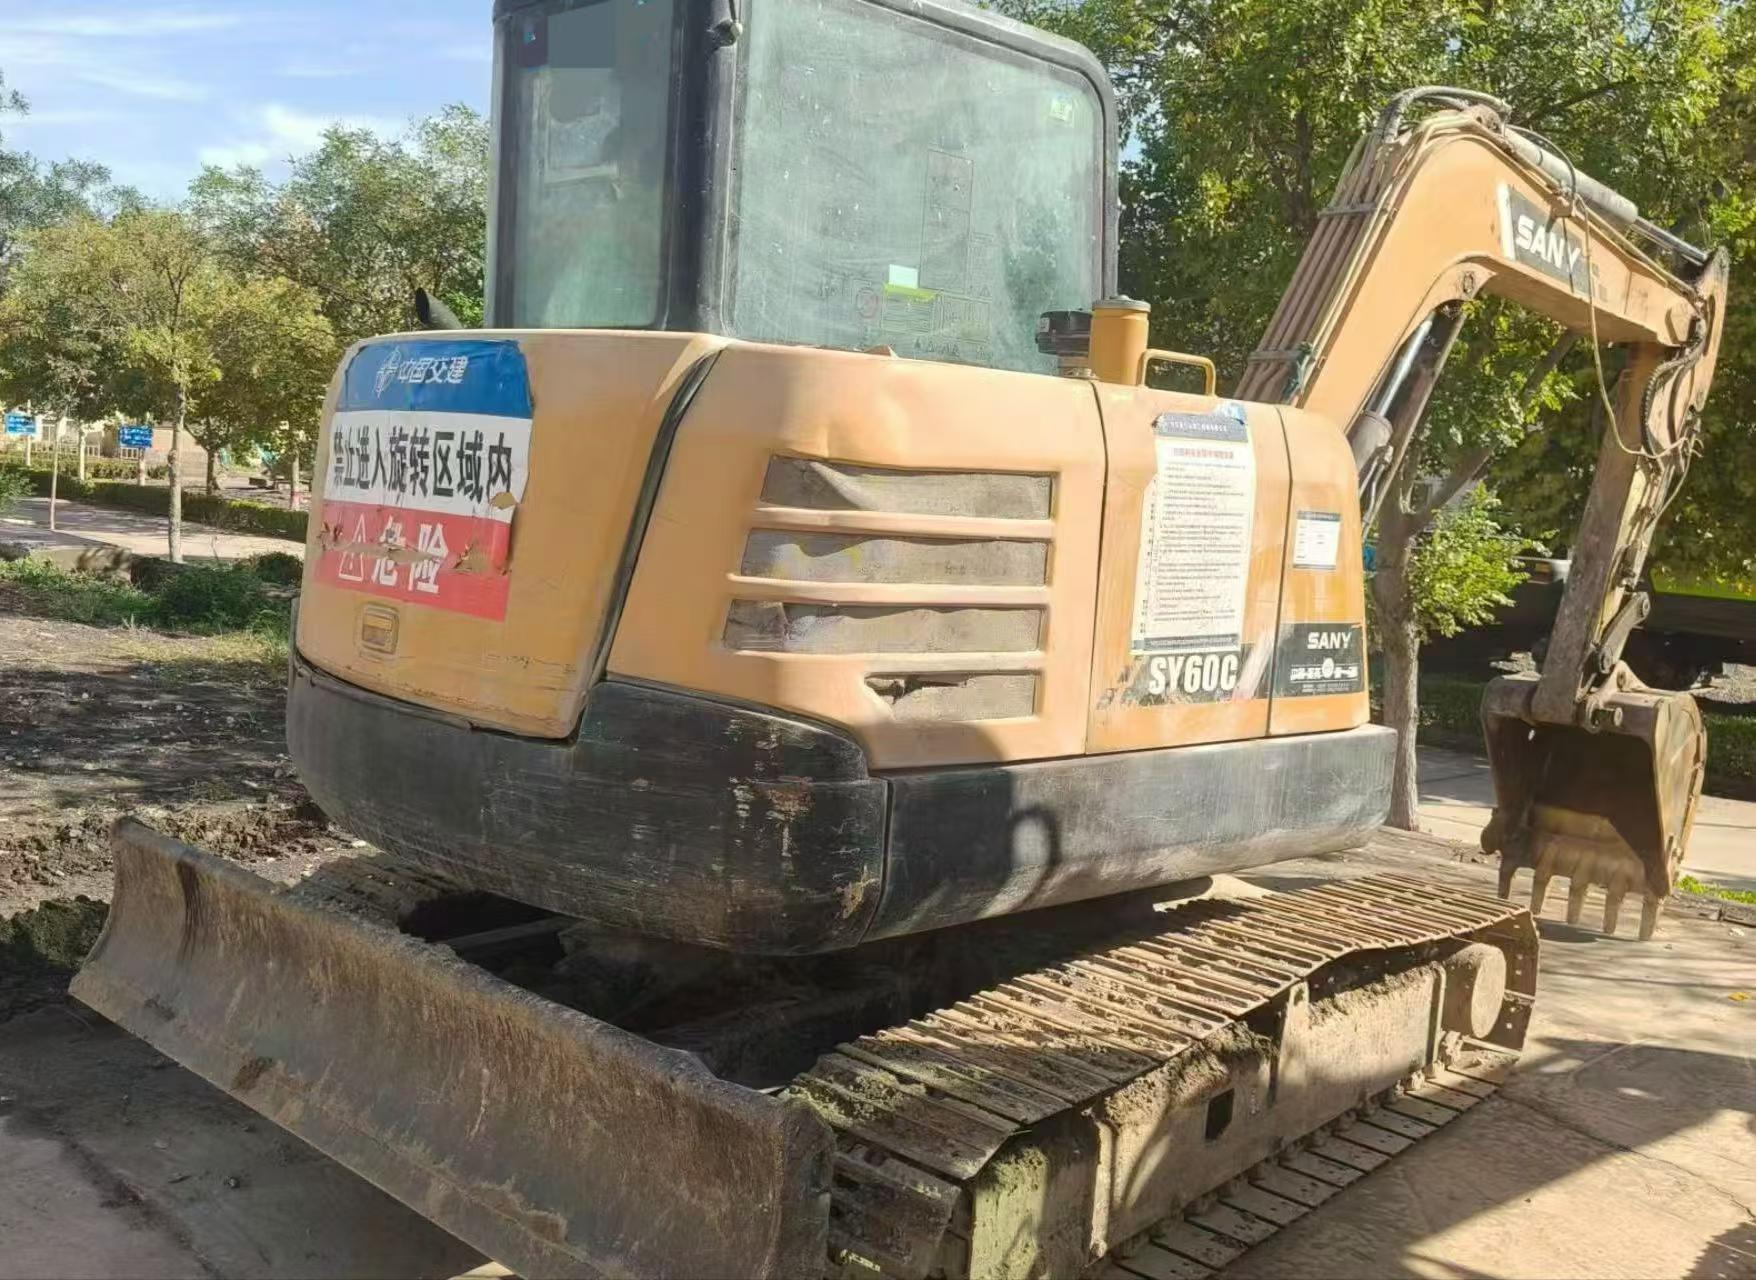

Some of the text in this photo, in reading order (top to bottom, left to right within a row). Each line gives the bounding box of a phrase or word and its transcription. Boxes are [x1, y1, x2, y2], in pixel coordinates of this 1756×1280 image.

[1516, 214, 1581, 272] SANY
[398, 356, 468, 384] 中国交建
[333, 424, 513, 502] 禁止进入旋转区域内
[1307, 631, 1353, 650] SANY
[1149, 653, 1239, 695] SY60C
